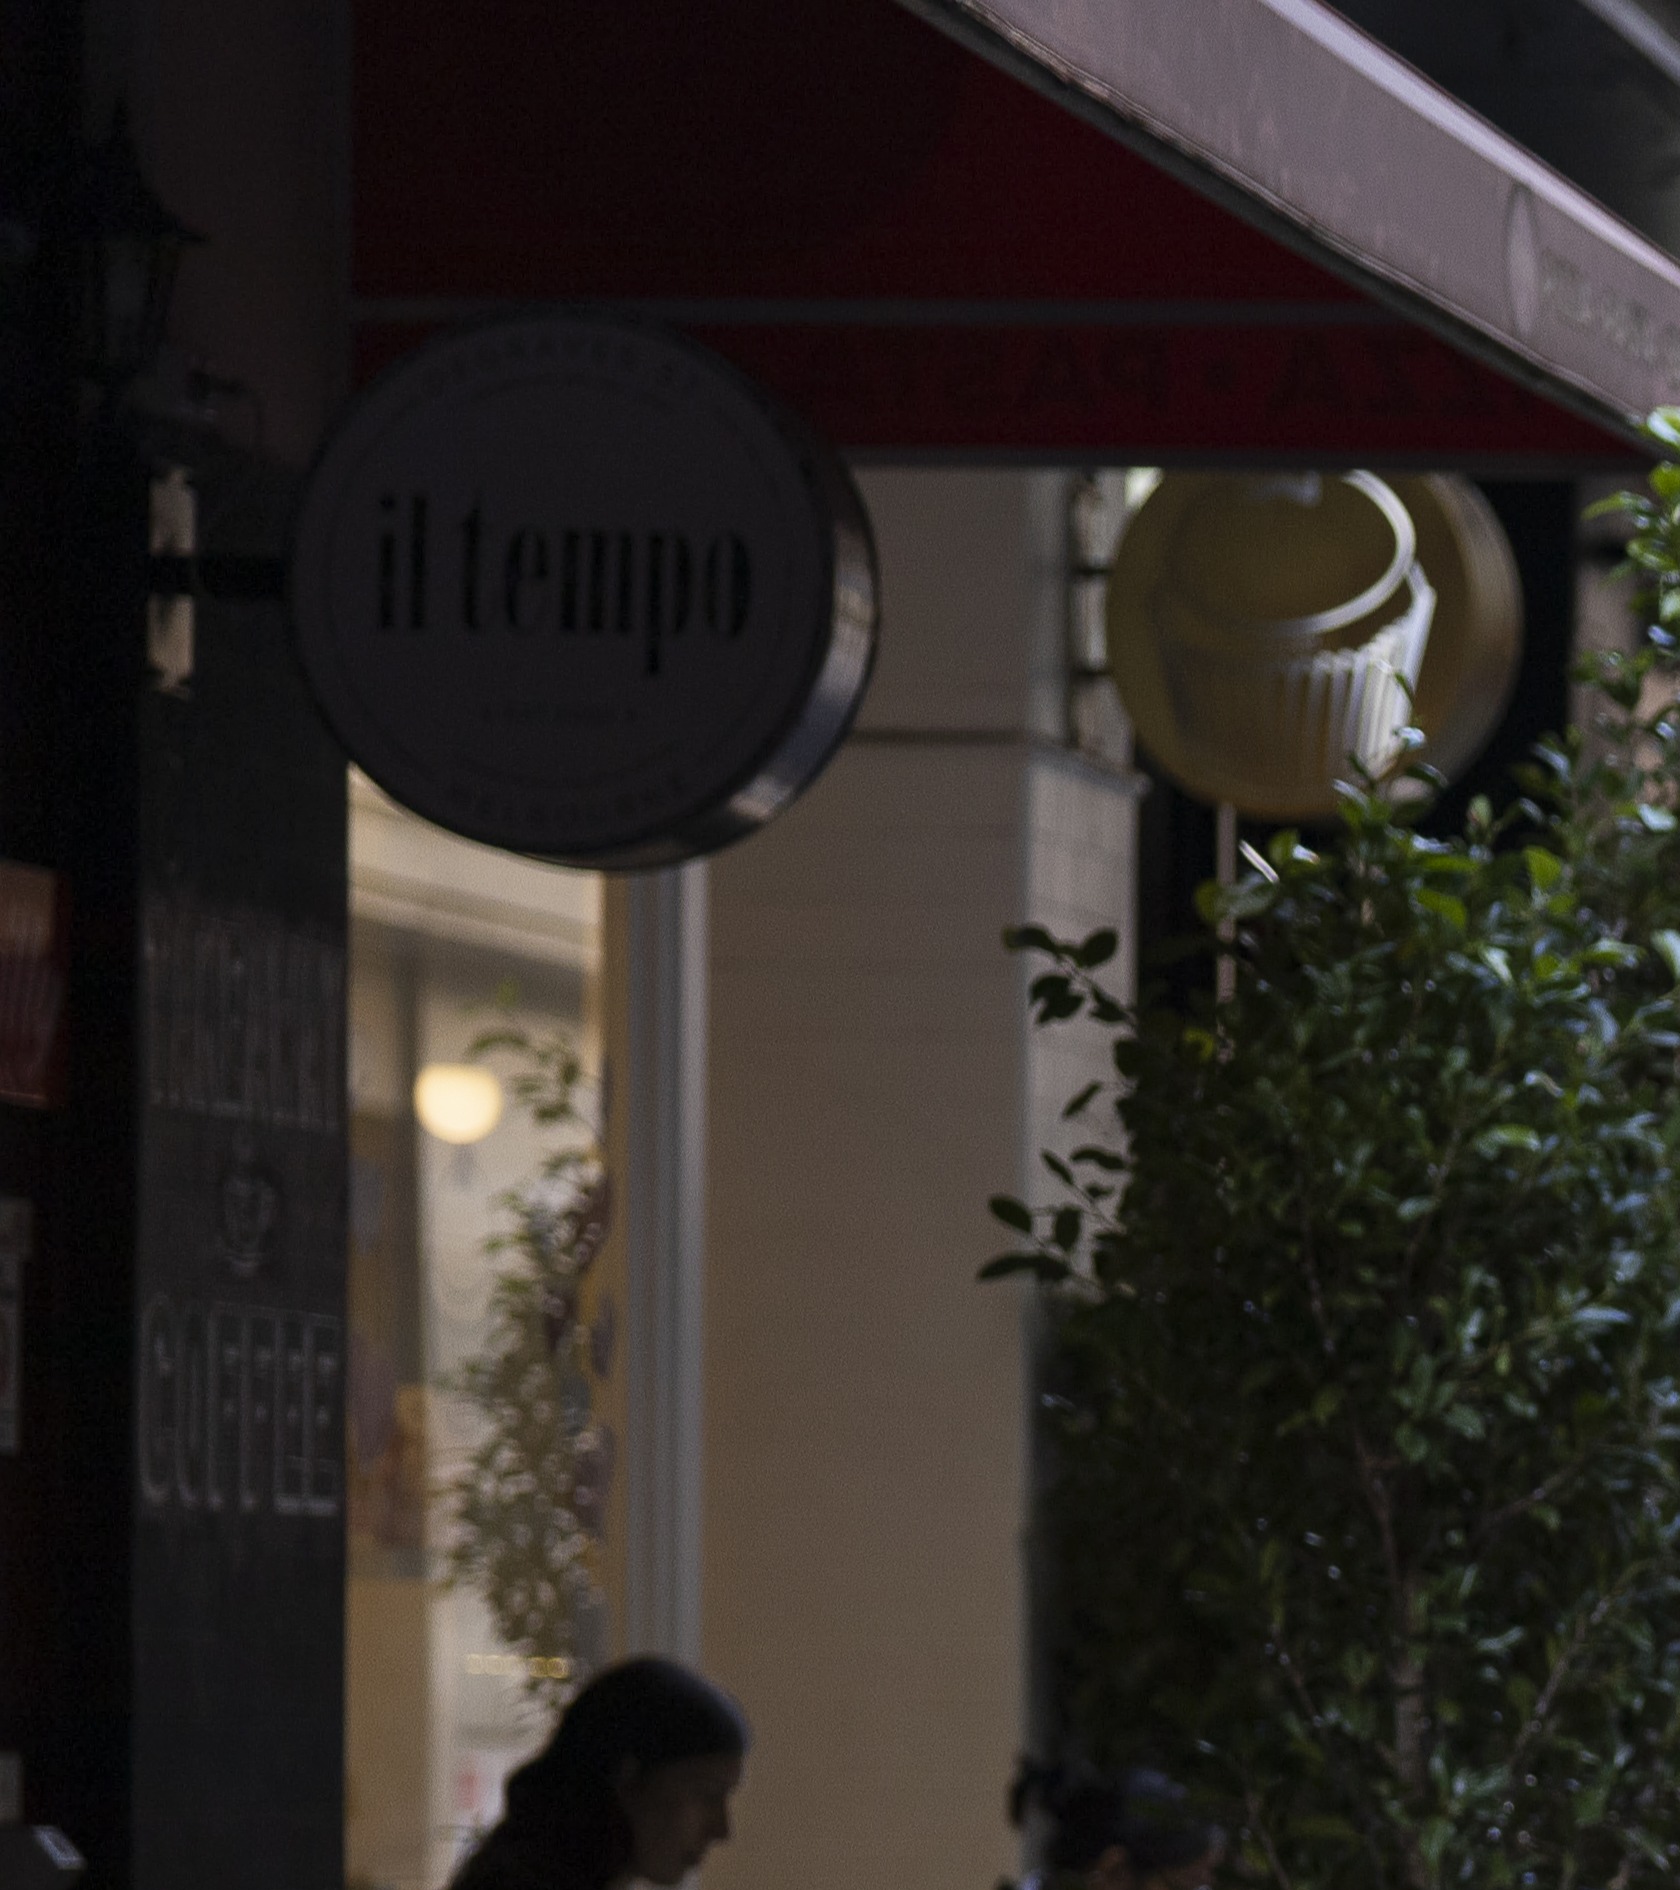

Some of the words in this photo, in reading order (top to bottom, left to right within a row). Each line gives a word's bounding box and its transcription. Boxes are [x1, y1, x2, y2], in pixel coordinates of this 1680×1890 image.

[376, 494, 428, 632] il
[459, 488, 753, 677] tempo
[136, 1290, 339, 1515] COFFEE
